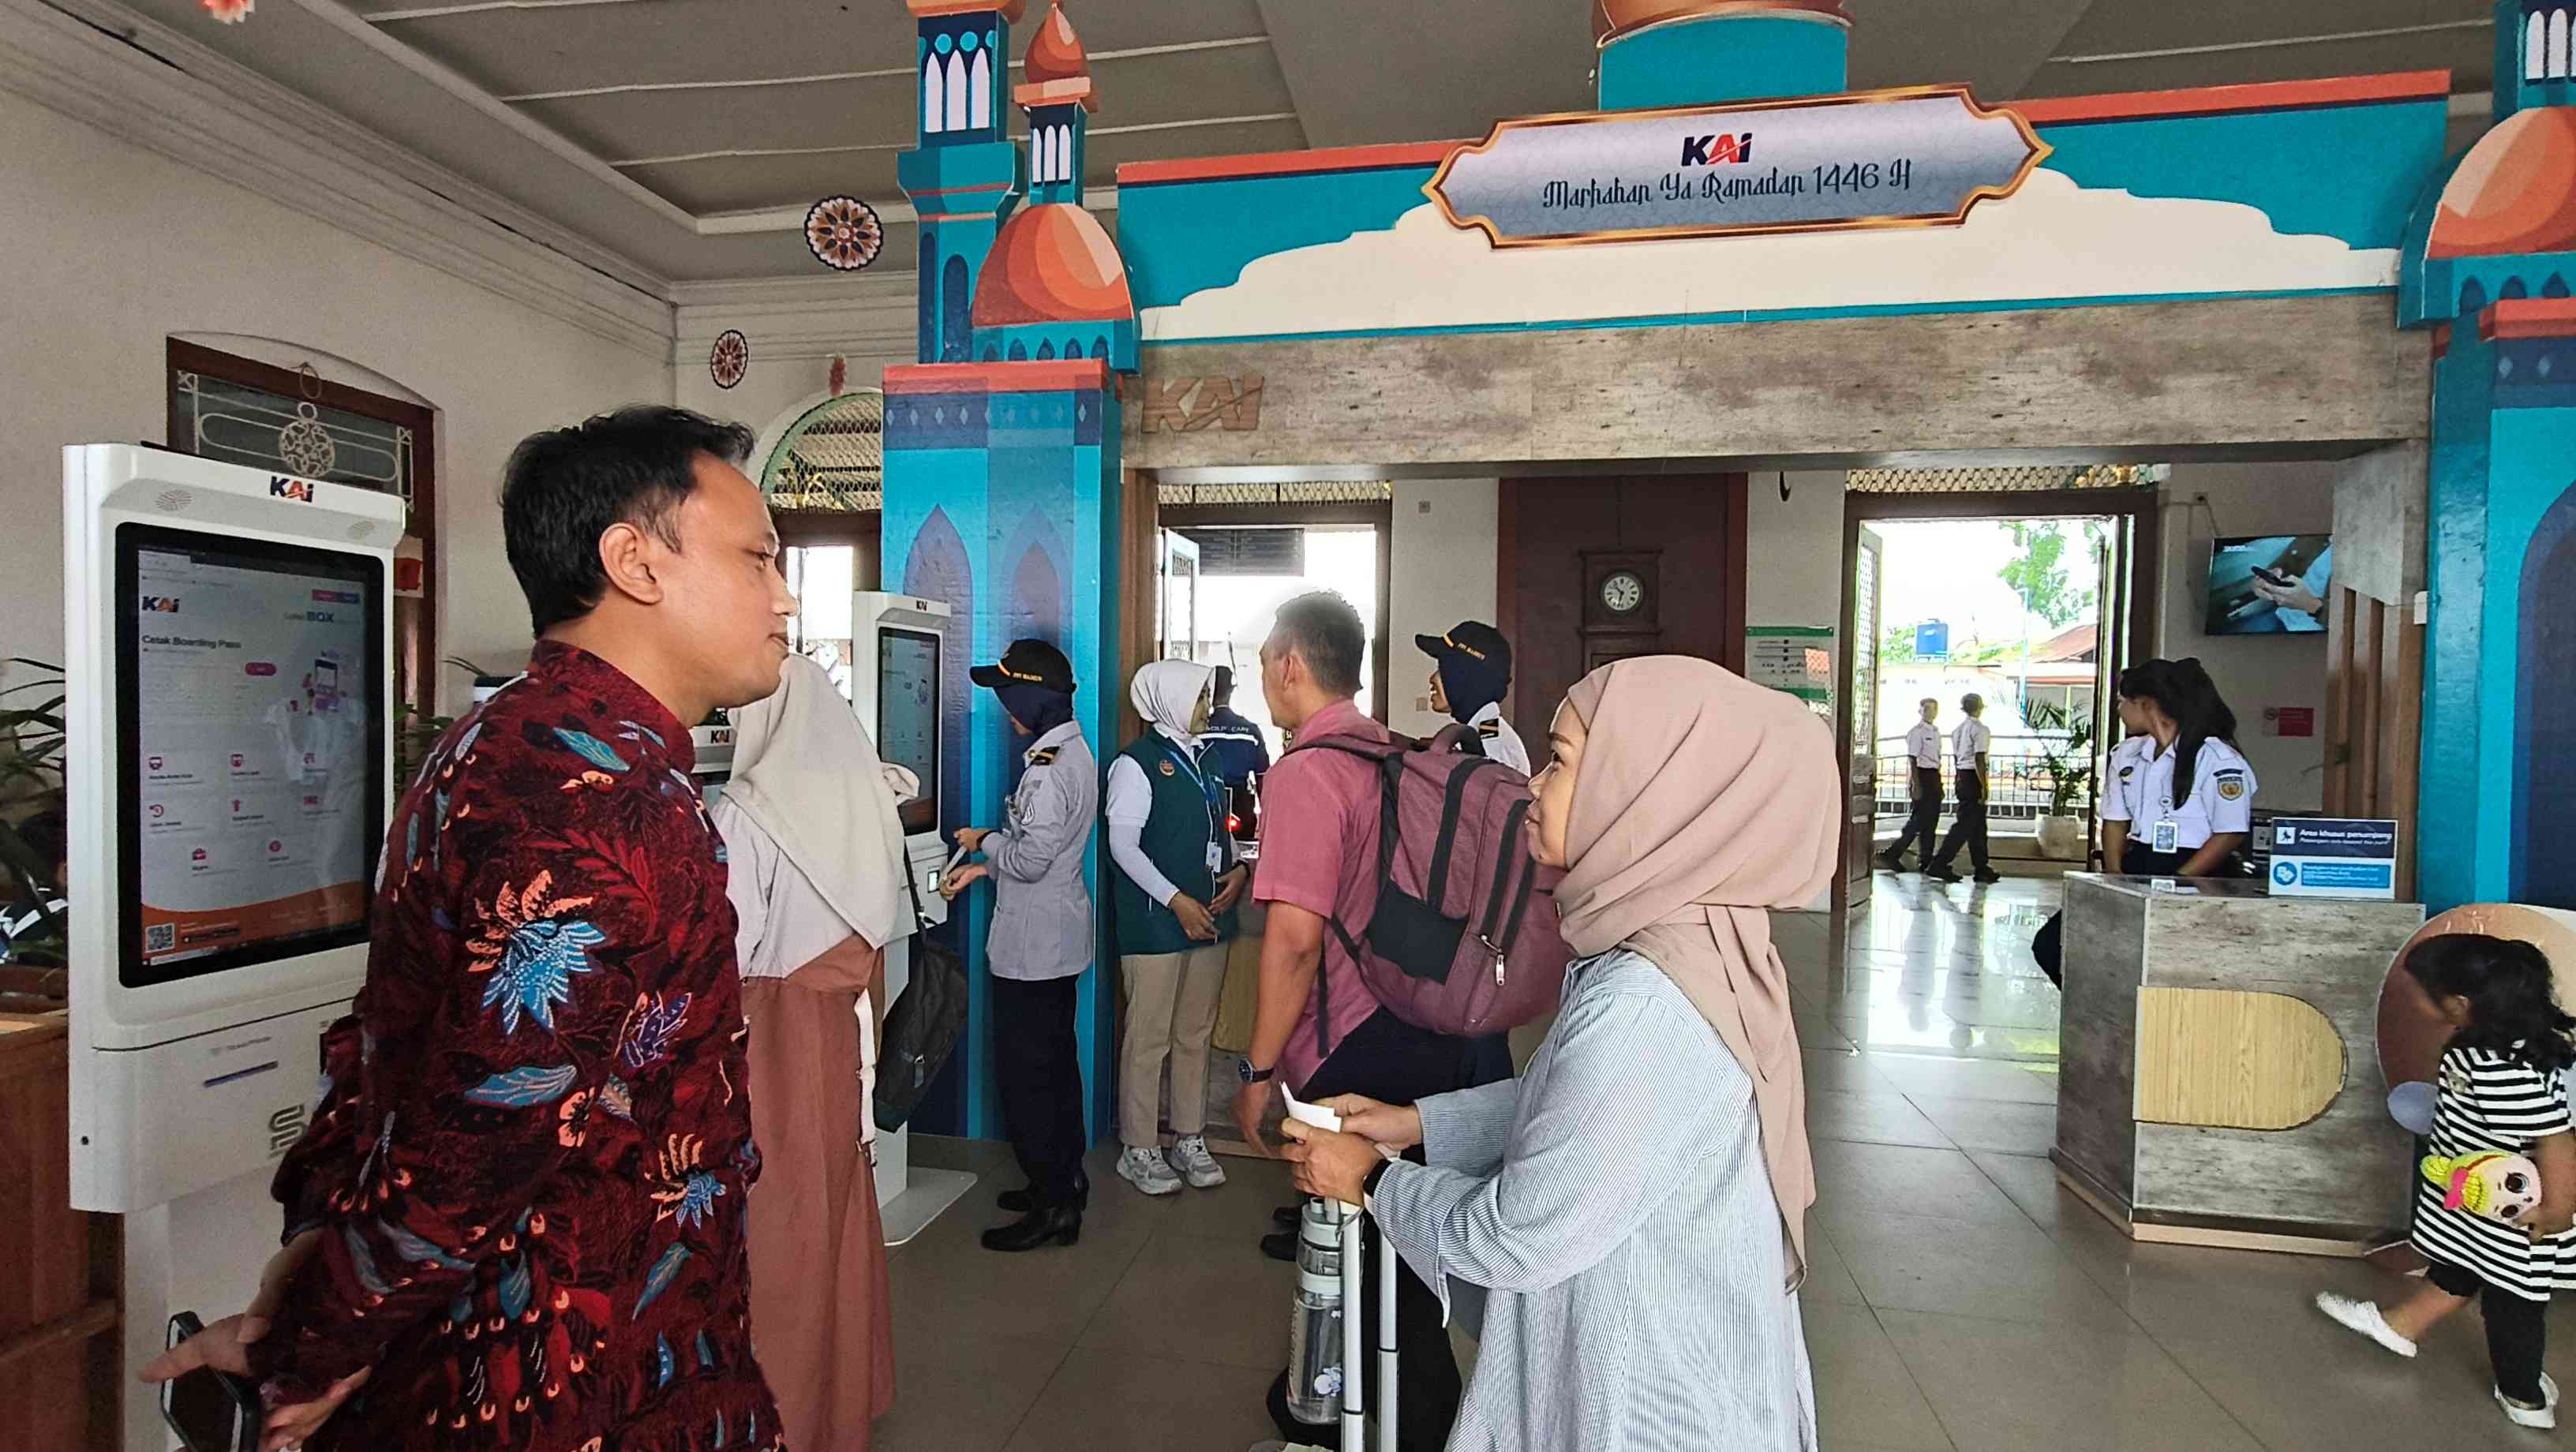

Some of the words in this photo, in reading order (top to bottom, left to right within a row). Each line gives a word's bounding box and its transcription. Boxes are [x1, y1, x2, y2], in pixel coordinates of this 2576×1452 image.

[1681, 133, 1753, 167] KAI
[1660, 172, 1693, 200] Ya
[1702, 166, 1806, 204] Ramadan
[1813, 163, 1880, 194] 1446
[1889, 159, 1912, 190] H
[1141, 376, 1264, 433] KAI
[270, 475, 314, 503] KAI
[142, 596, 180, 613] KAI
[173, 636, 217, 649] Boarding
[710, 730, 730, 744] KAI
